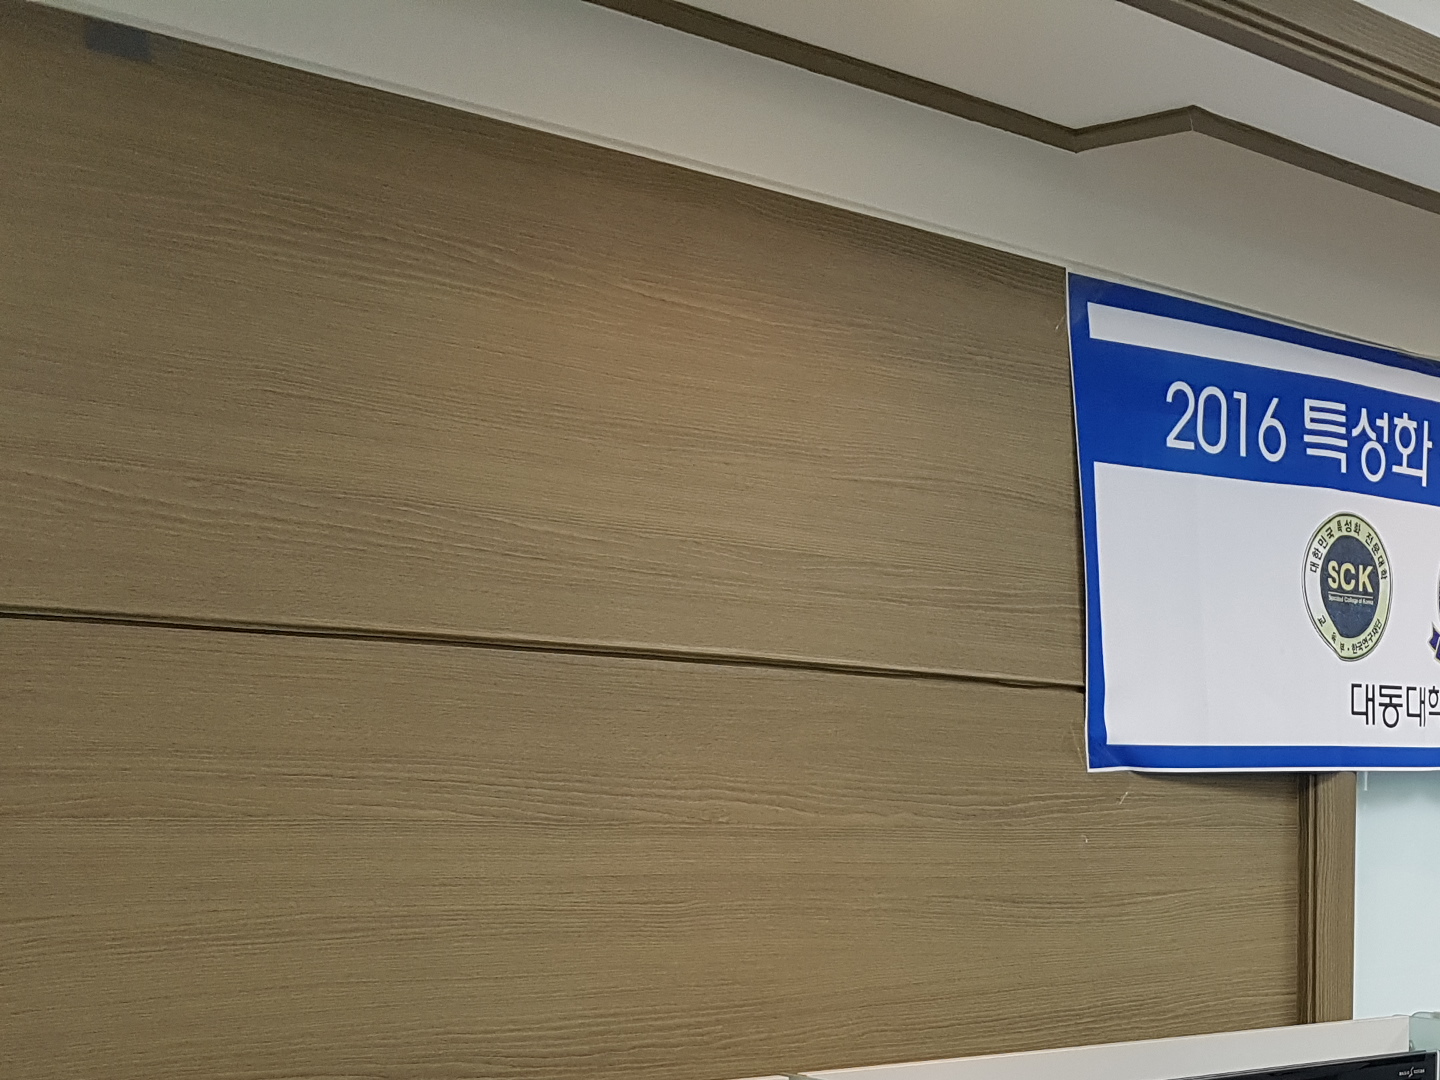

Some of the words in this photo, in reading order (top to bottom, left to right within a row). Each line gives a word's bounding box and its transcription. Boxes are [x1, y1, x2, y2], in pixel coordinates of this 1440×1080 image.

[1165, 380, 1287, 462] 2016
[1303, 398, 1432, 488] 특성화
[1310, 527, 1335, 573] 대한민국
[1328, 560, 1374, 593] SCK
